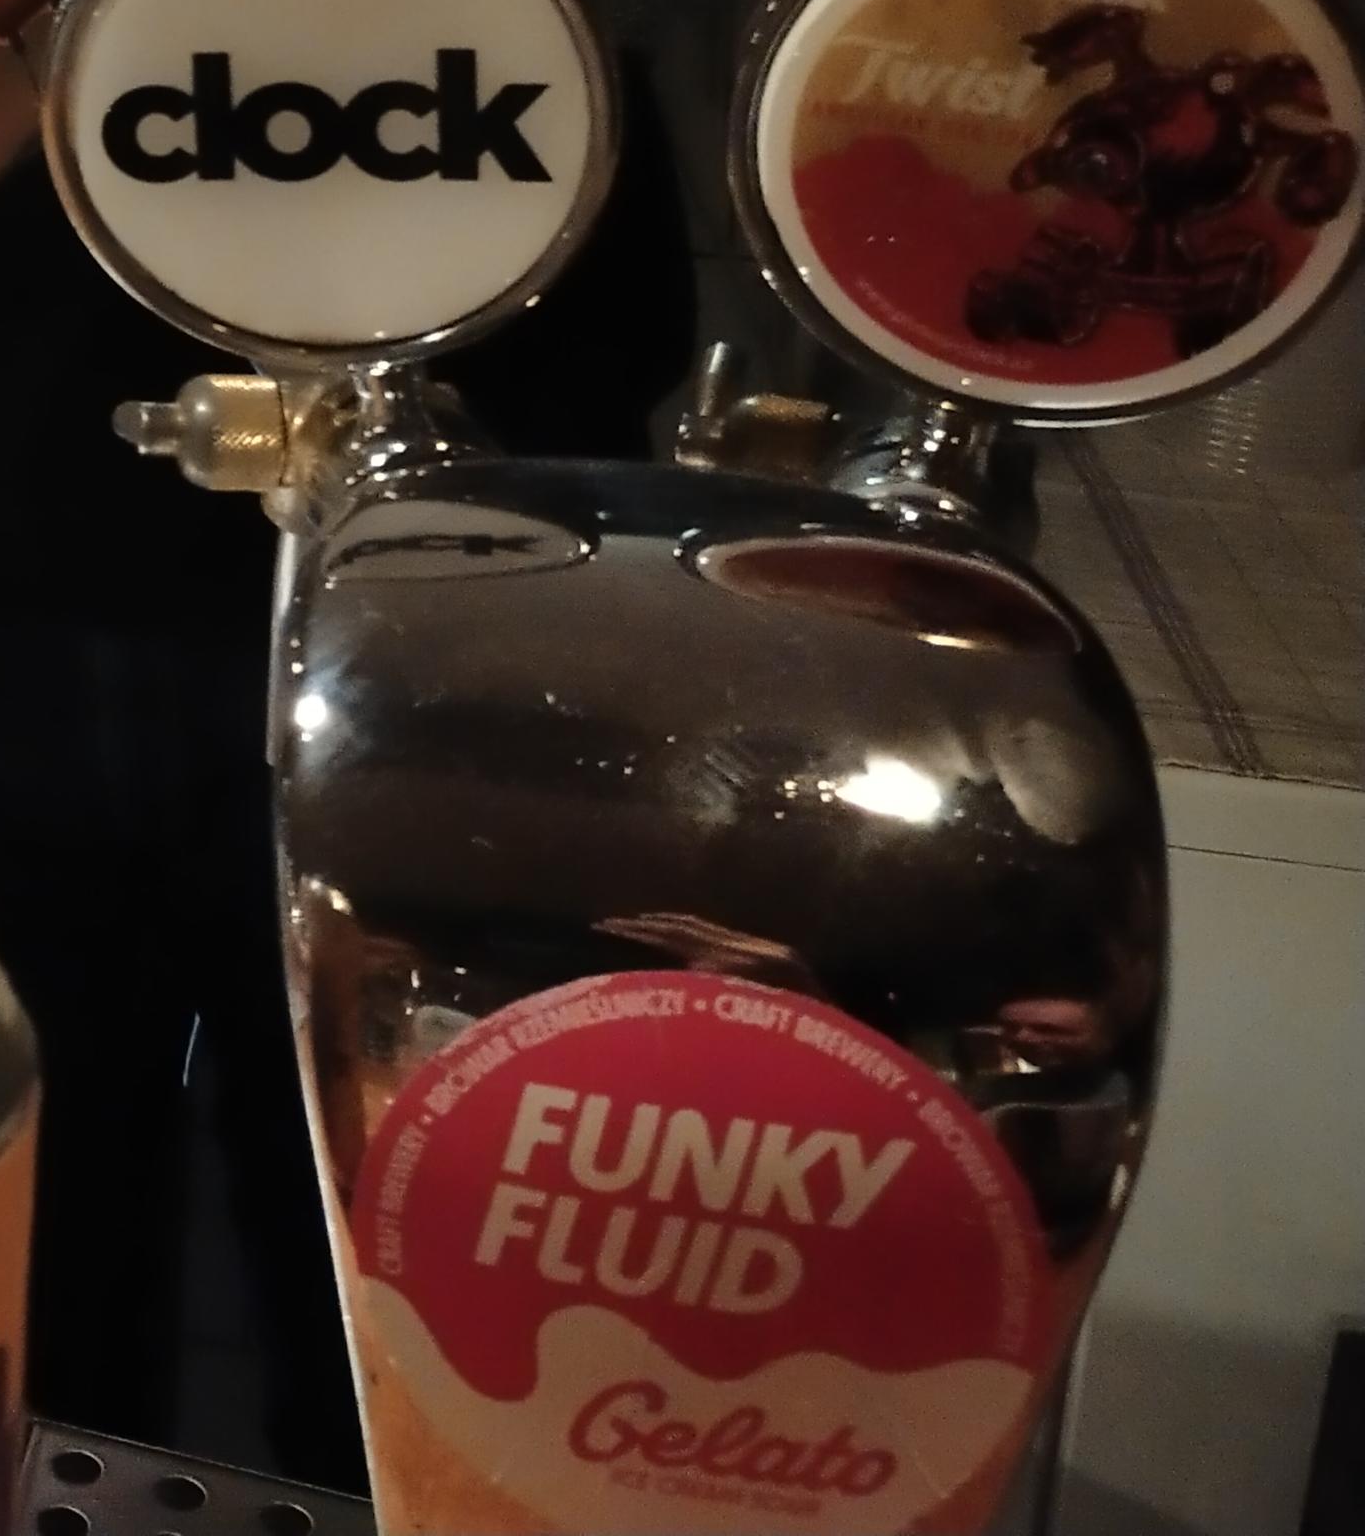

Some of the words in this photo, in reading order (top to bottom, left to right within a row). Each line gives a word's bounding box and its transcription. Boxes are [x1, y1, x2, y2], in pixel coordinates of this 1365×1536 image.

[100, 48, 553, 184] clock
[839, 35, 1041, 119] Twist
[714, 993, 795, 1033] CRAFT
[502, 1083, 915, 1231] FUNKY
[474, 1190, 809, 1315] FLUID
[569, 1380, 896, 1495] Gelato
